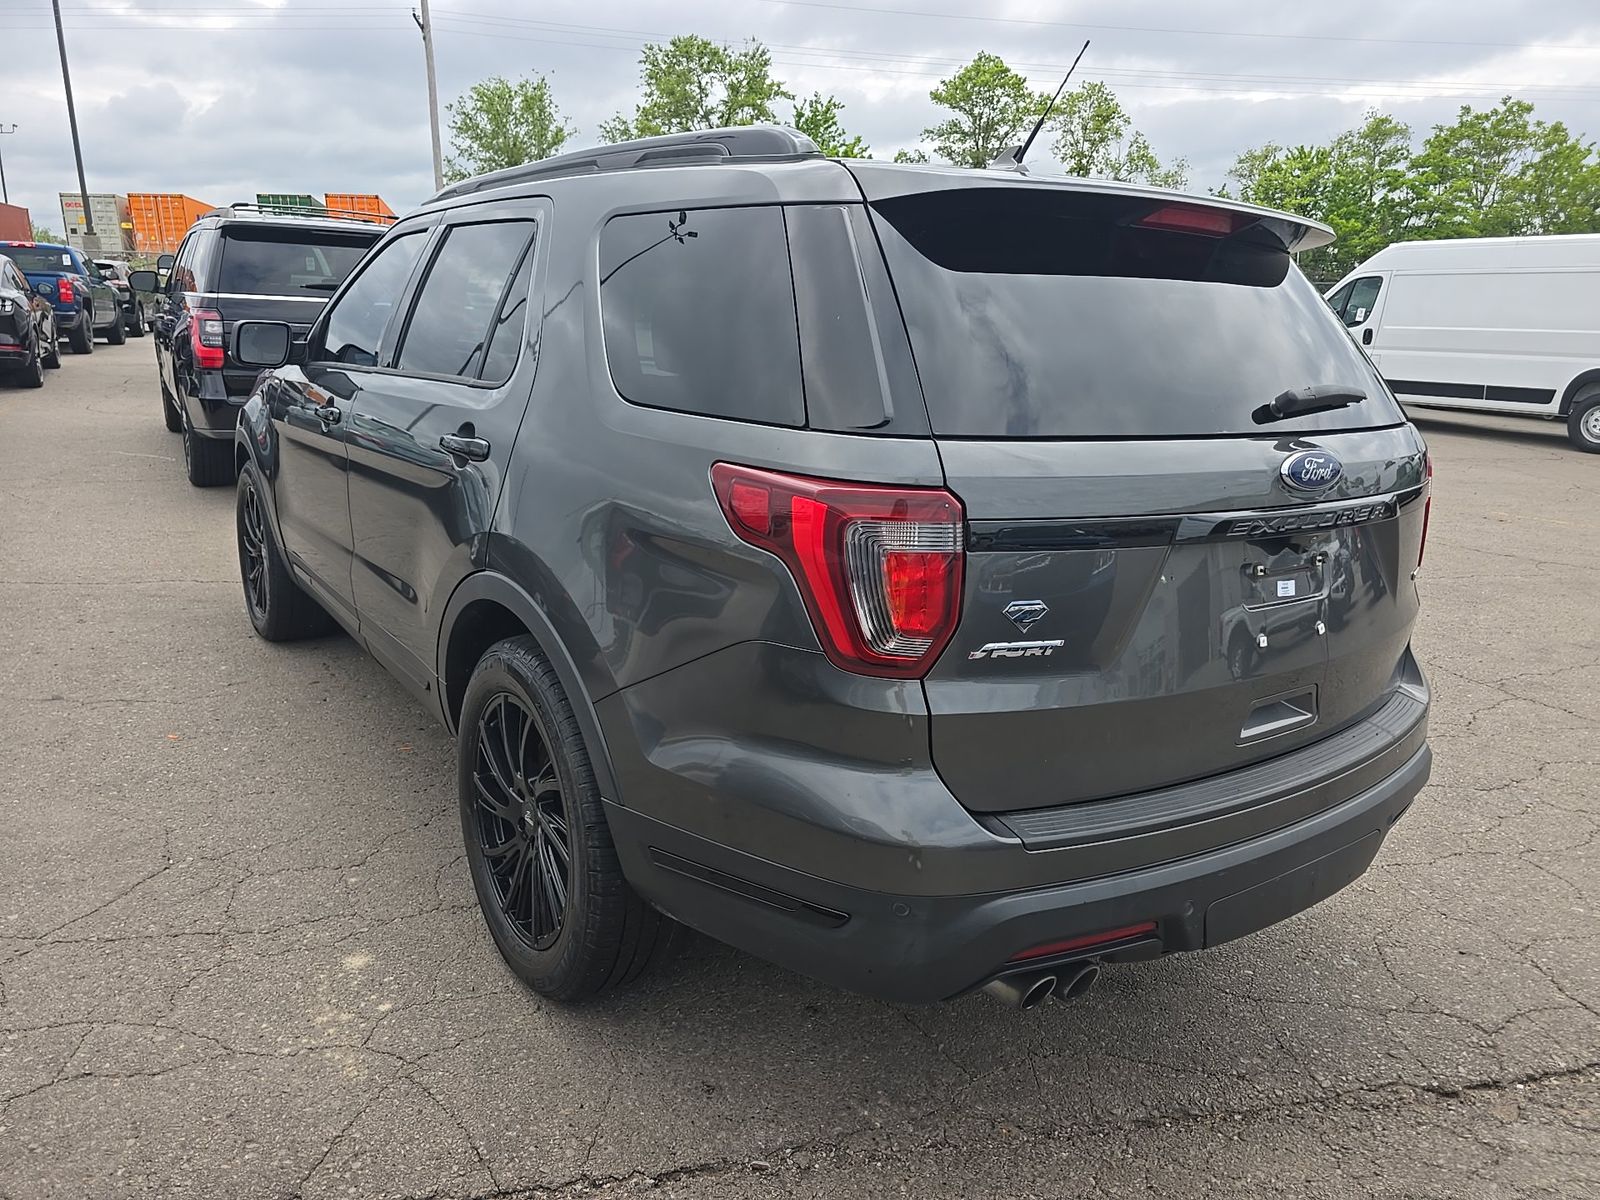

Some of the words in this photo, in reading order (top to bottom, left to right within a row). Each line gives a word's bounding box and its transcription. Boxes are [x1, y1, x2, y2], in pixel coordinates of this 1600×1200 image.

[1301, 456, 1334, 482] Ford
[1226, 505, 1386, 536] EXPLORER
[967, 640, 1065, 660] SPORT
